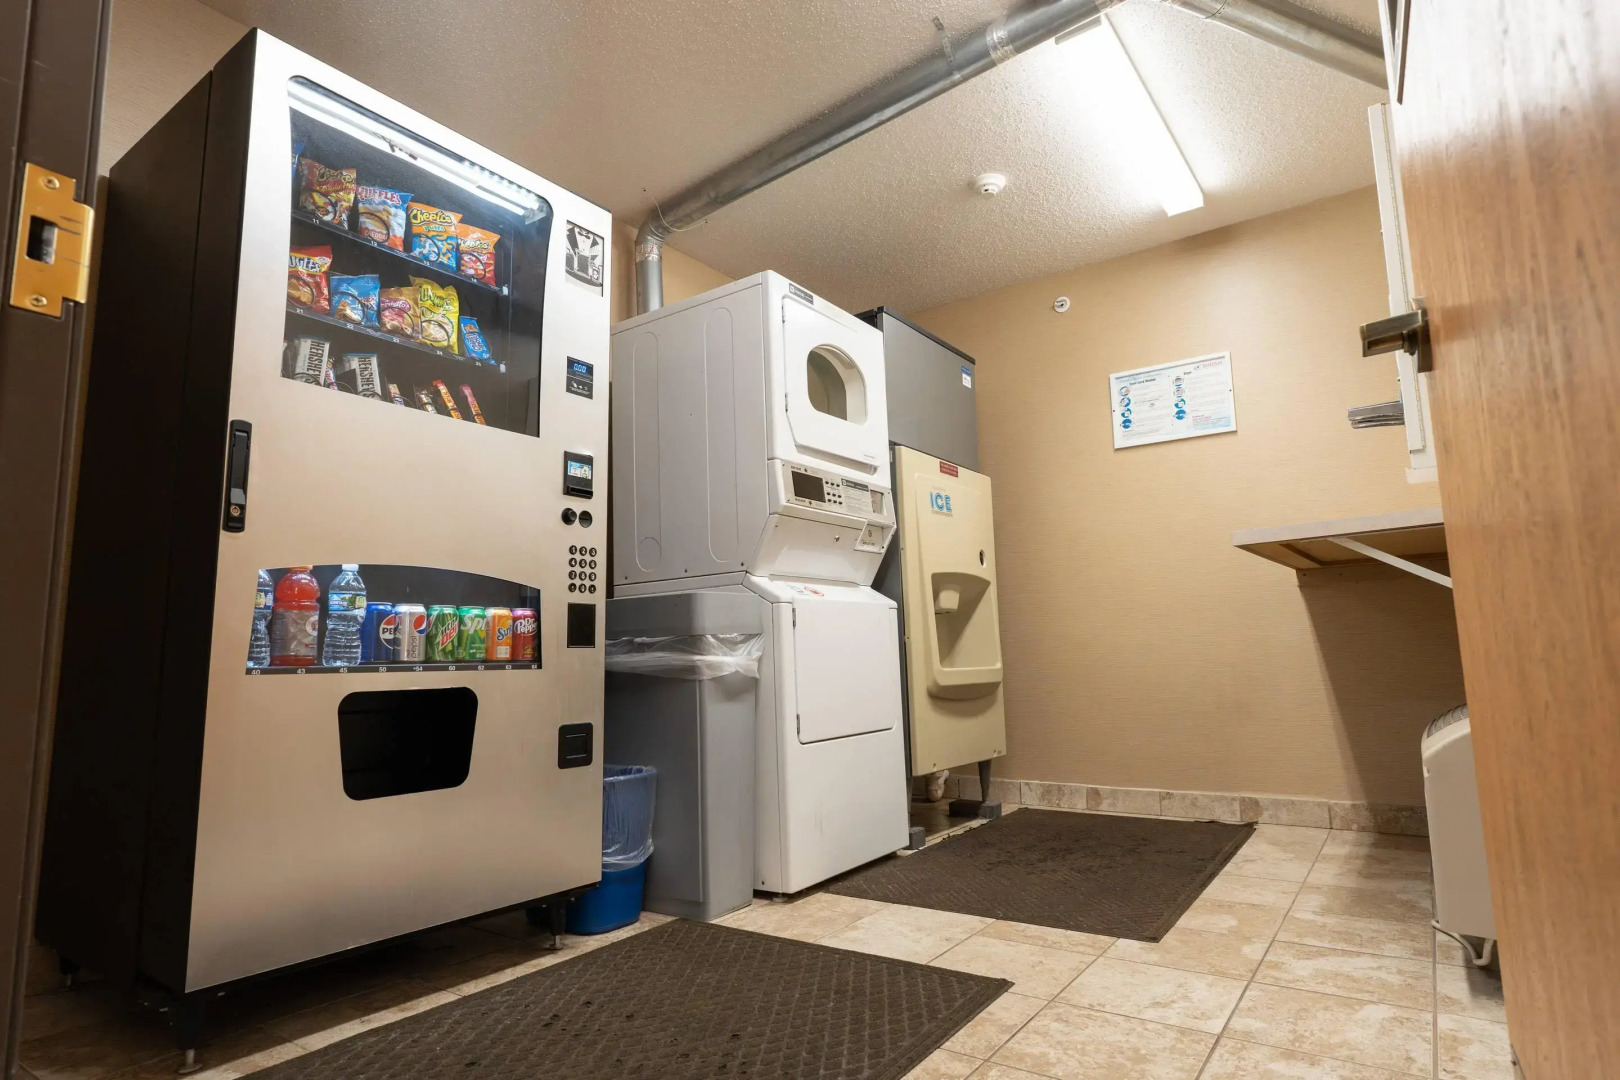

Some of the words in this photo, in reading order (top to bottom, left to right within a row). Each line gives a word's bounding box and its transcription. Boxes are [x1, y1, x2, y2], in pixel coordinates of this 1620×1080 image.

[356, 185, 401, 205] RUFFLES
[410, 208, 452, 223] Cheetos
[289, 255, 321, 273] UGLES
[304, 340, 325, 385] HERSHEYS
[930, 491, 952, 513] ICE
[525, 618, 535, 626] Dr
[410, 635, 418, 659] pepsi
